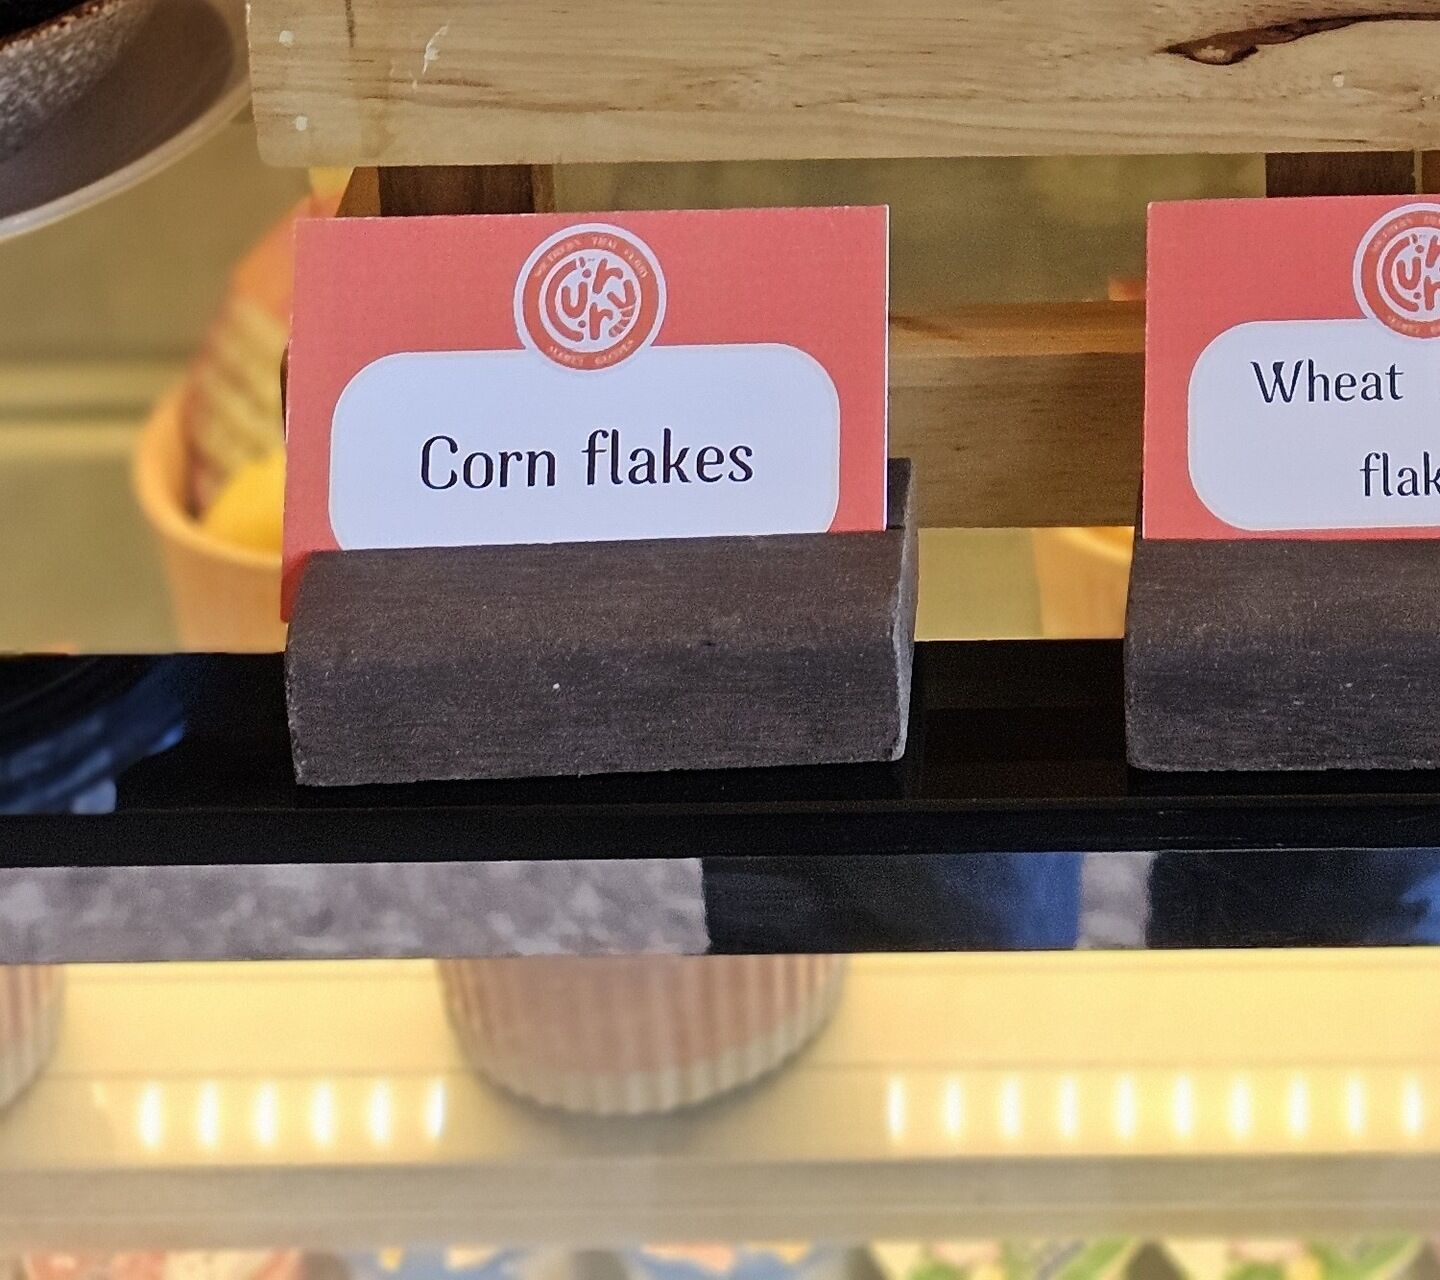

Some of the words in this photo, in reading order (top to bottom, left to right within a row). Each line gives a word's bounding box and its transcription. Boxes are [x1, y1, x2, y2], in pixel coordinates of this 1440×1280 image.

[1250, 358, 1404, 404] Wheat
[420, 435, 556, 490] Corn
[581, 429, 754, 486] flakes
